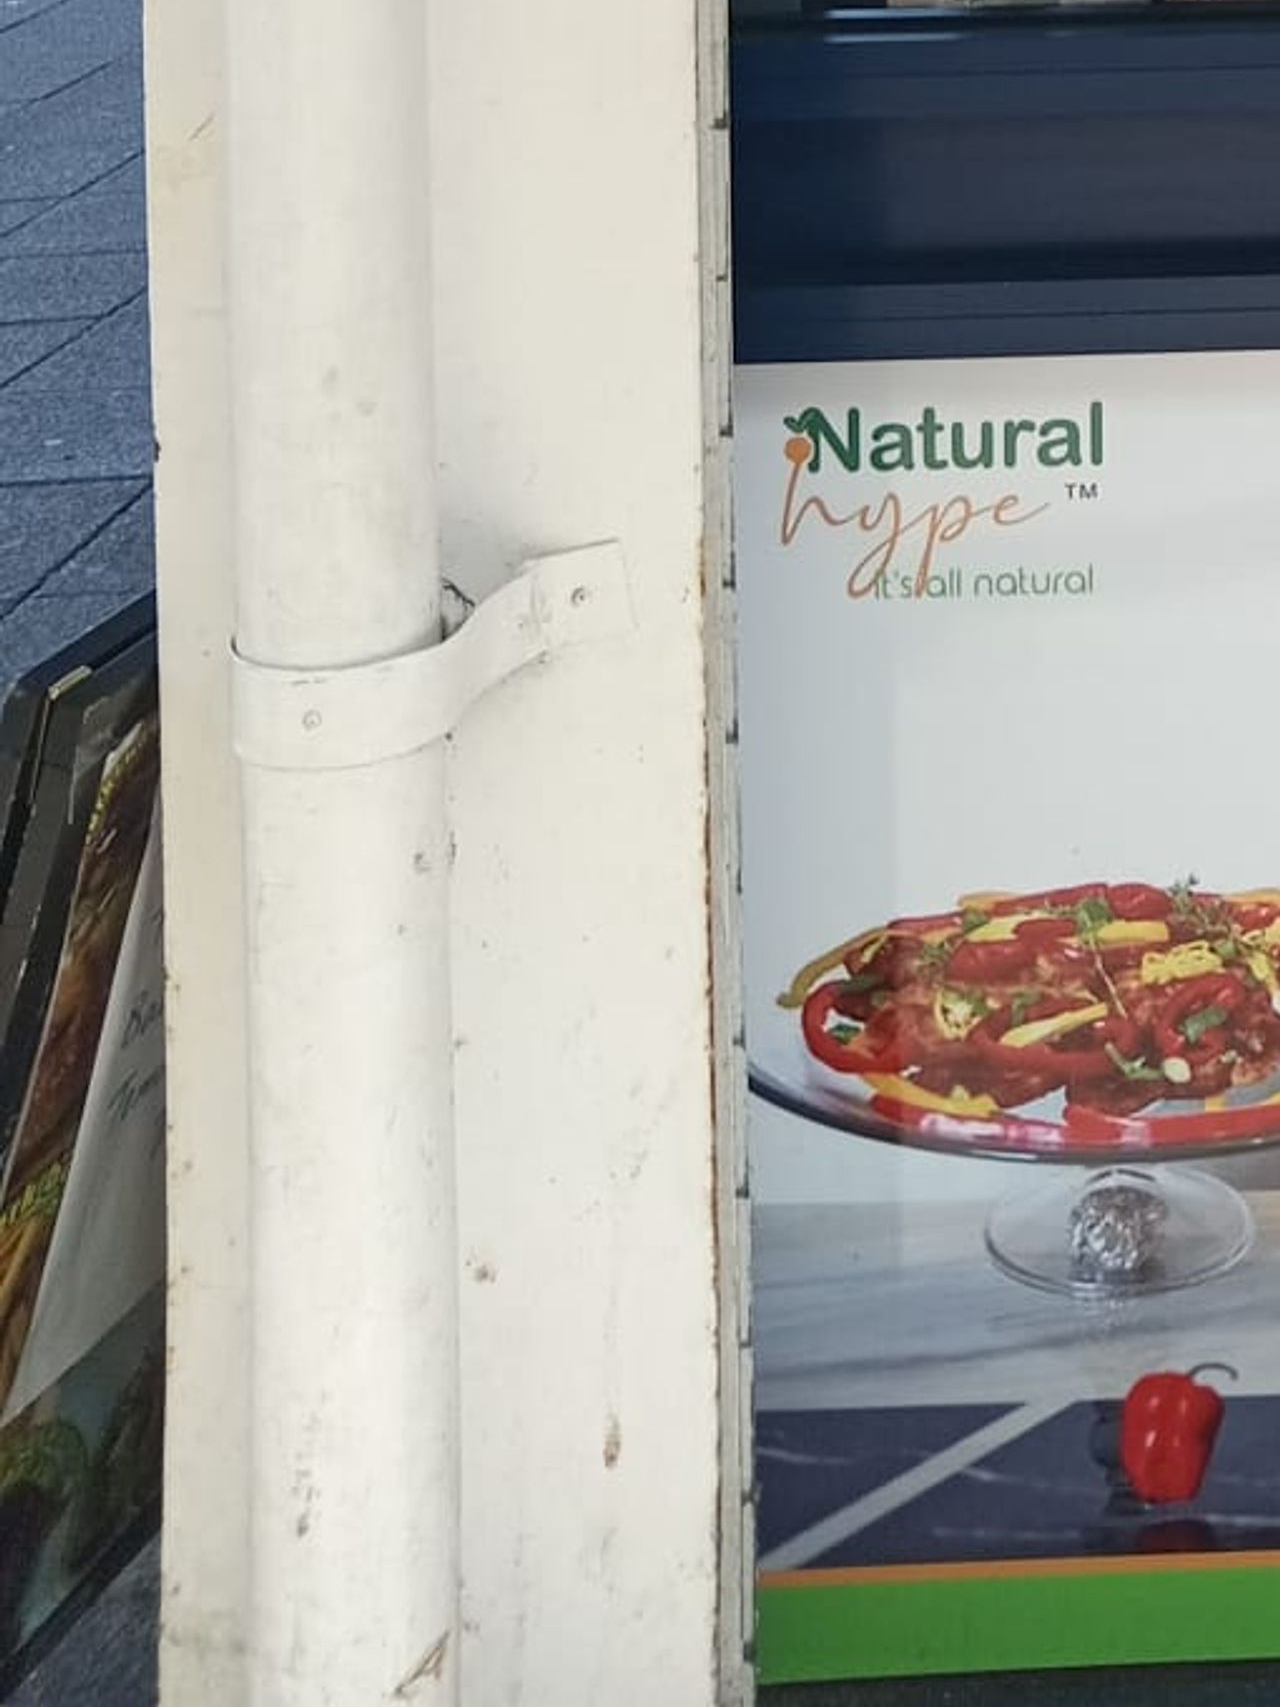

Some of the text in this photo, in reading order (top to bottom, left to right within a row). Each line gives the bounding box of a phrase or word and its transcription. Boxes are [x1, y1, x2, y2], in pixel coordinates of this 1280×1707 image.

[800, 400, 1104, 474] Natural
[925, 567, 963, 598] all
[973, 563, 1094, 597] natural
